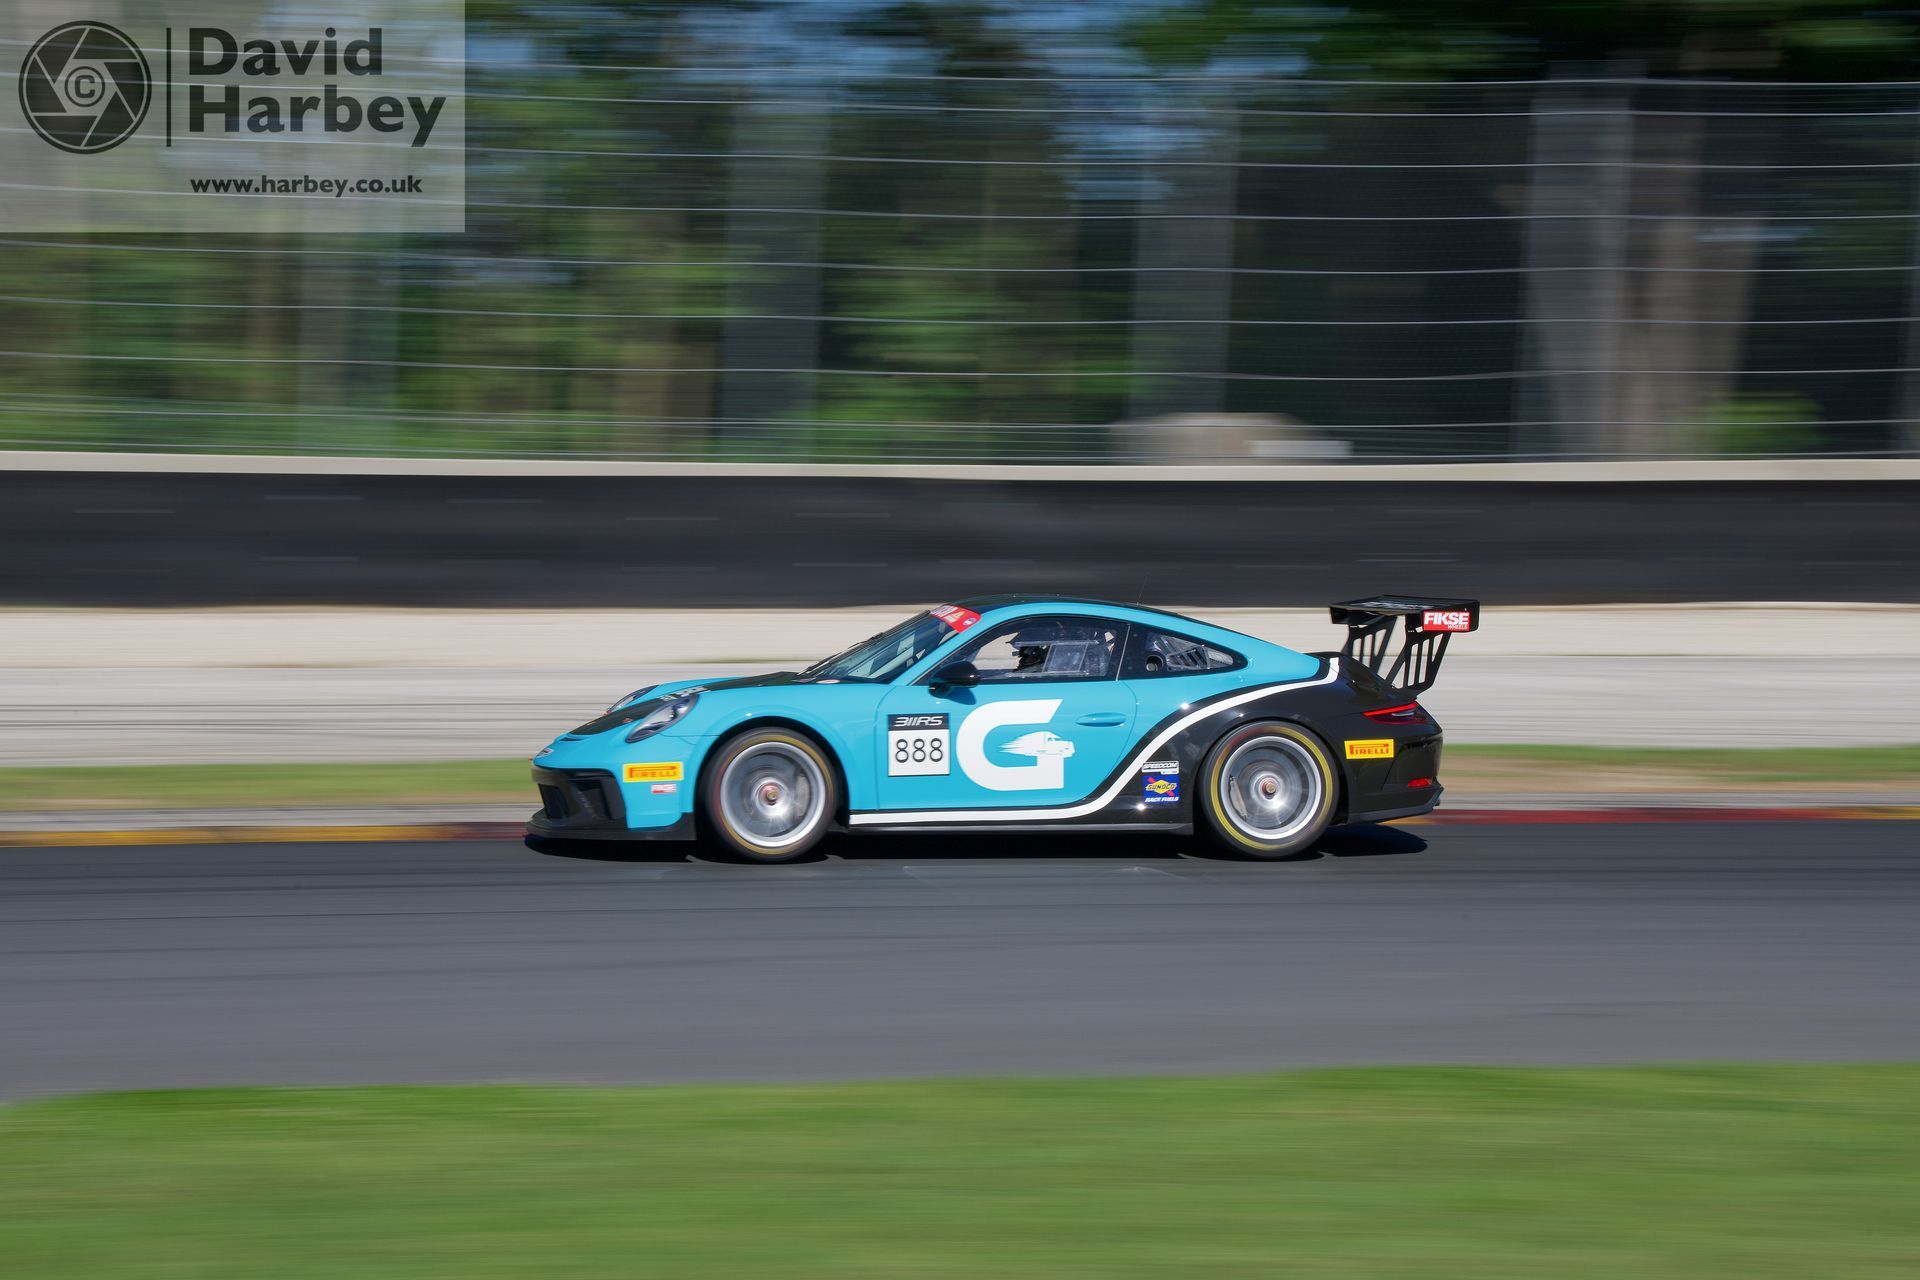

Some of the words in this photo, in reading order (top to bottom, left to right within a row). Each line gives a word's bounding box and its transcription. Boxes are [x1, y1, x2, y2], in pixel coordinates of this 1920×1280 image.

[1424, 612, 1469, 625] FIKSE
[895, 738, 943, 763] 888
[956, 699, 1064, 791] G
[1349, 743, 1390, 755] PIRELLI
[628, 766, 677, 778] PIRELLI
[1146, 783, 1177, 791] SUNOCO
